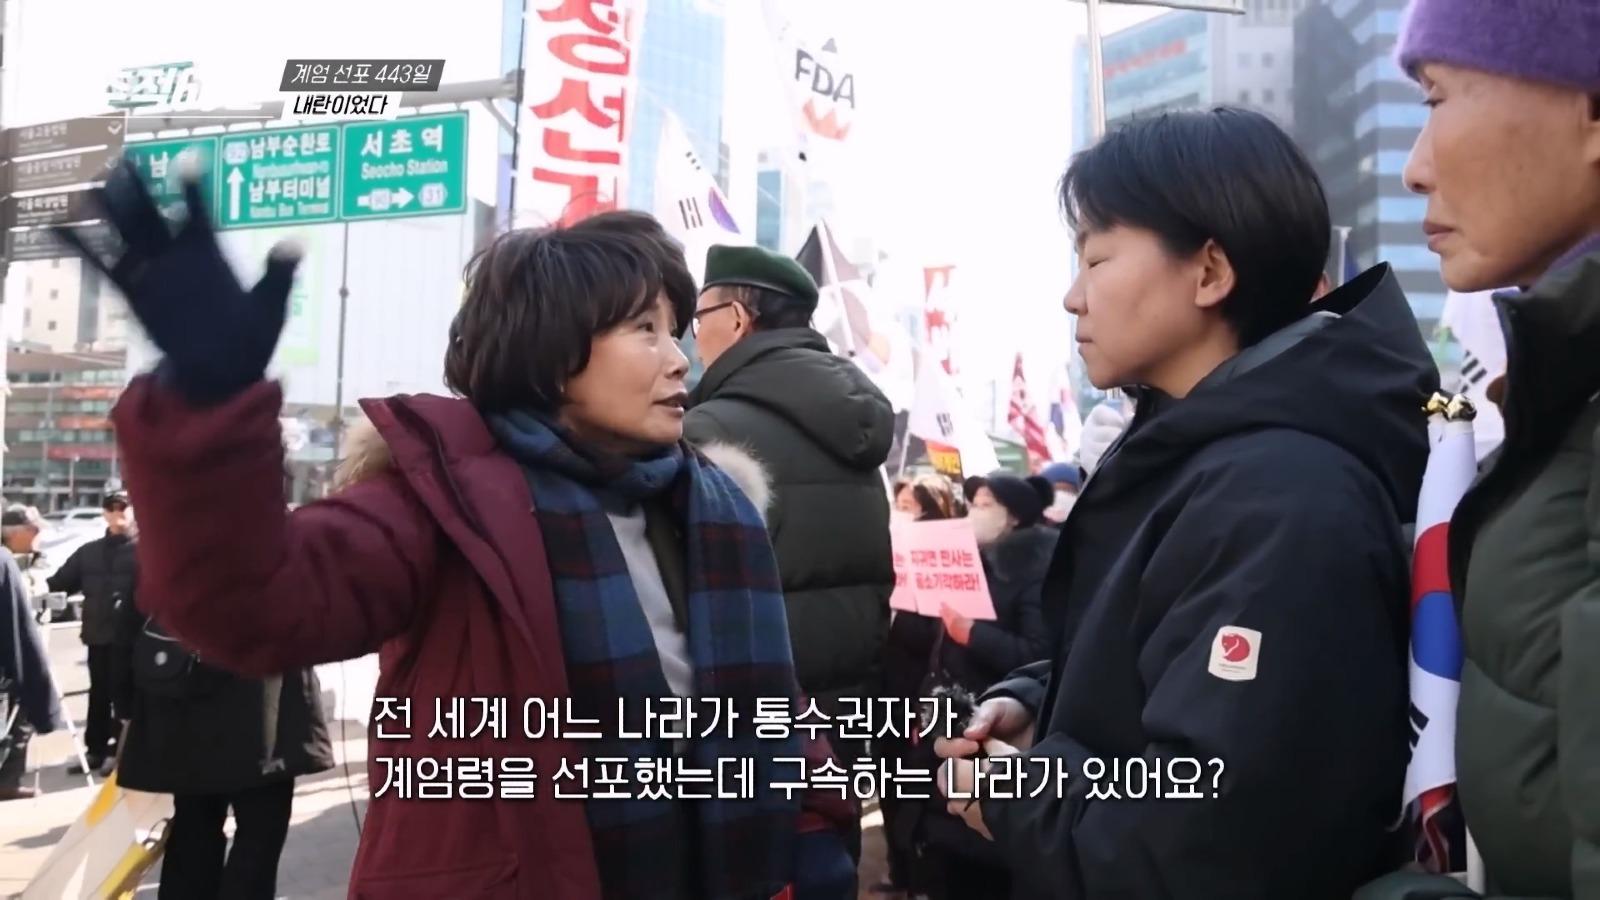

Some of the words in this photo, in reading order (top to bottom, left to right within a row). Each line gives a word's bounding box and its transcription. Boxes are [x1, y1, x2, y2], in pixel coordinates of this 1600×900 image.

[795, 49, 856, 109] FDA
[250, 132, 332, 160] 남부순환로
[361, 162, 405, 180] Seocho
[406, 159, 448, 176] Station
[249, 175, 330, 204] 남부터미널
